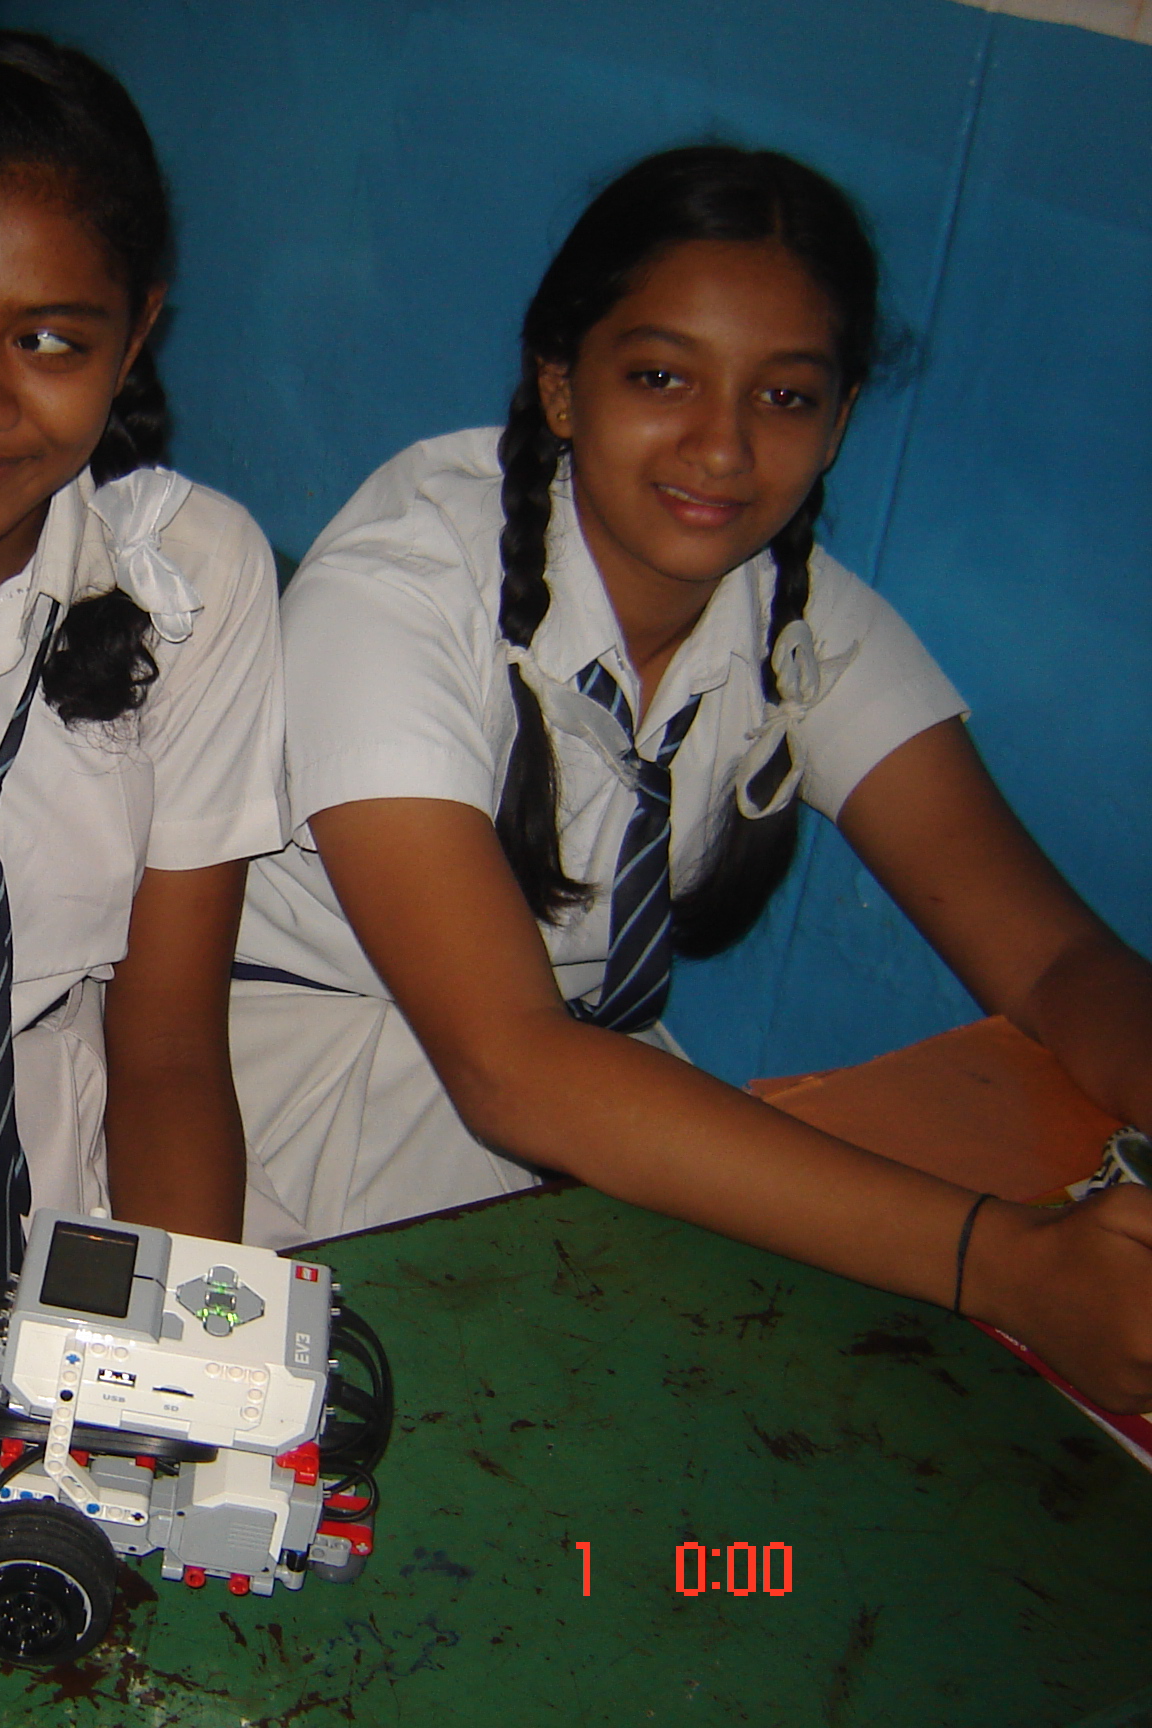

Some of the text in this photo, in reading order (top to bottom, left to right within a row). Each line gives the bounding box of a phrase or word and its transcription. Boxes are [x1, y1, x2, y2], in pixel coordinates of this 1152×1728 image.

[295, 1332, 311, 1365] EV3
[103, 1393, 126, 1403] USB
[163, 1404, 180, 1412] SD
